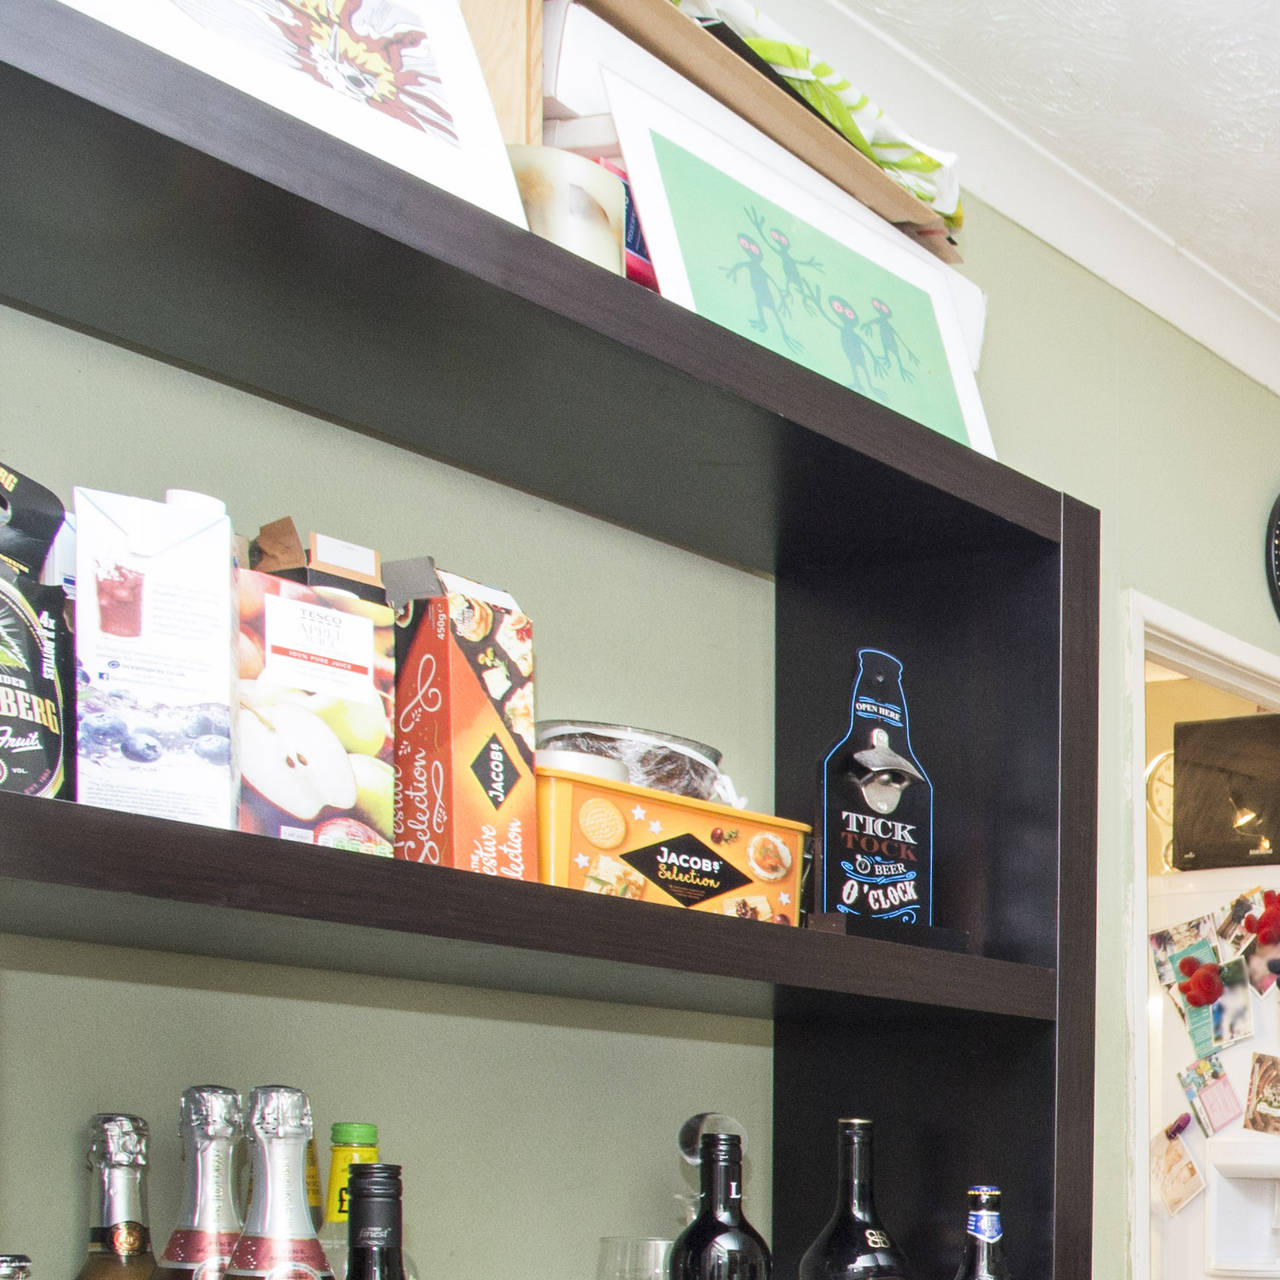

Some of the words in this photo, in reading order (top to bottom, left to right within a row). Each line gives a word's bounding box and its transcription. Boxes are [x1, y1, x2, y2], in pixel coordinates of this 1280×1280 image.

[855, 702, 878, 713] OPEN
[878, 707, 901, 721] HERE
[841, 811, 918, 845] TICK
[841, 830, 918, 862] TOCK
[657, 863, 721, 889] Selection
[874, 862, 907, 875] BEER
